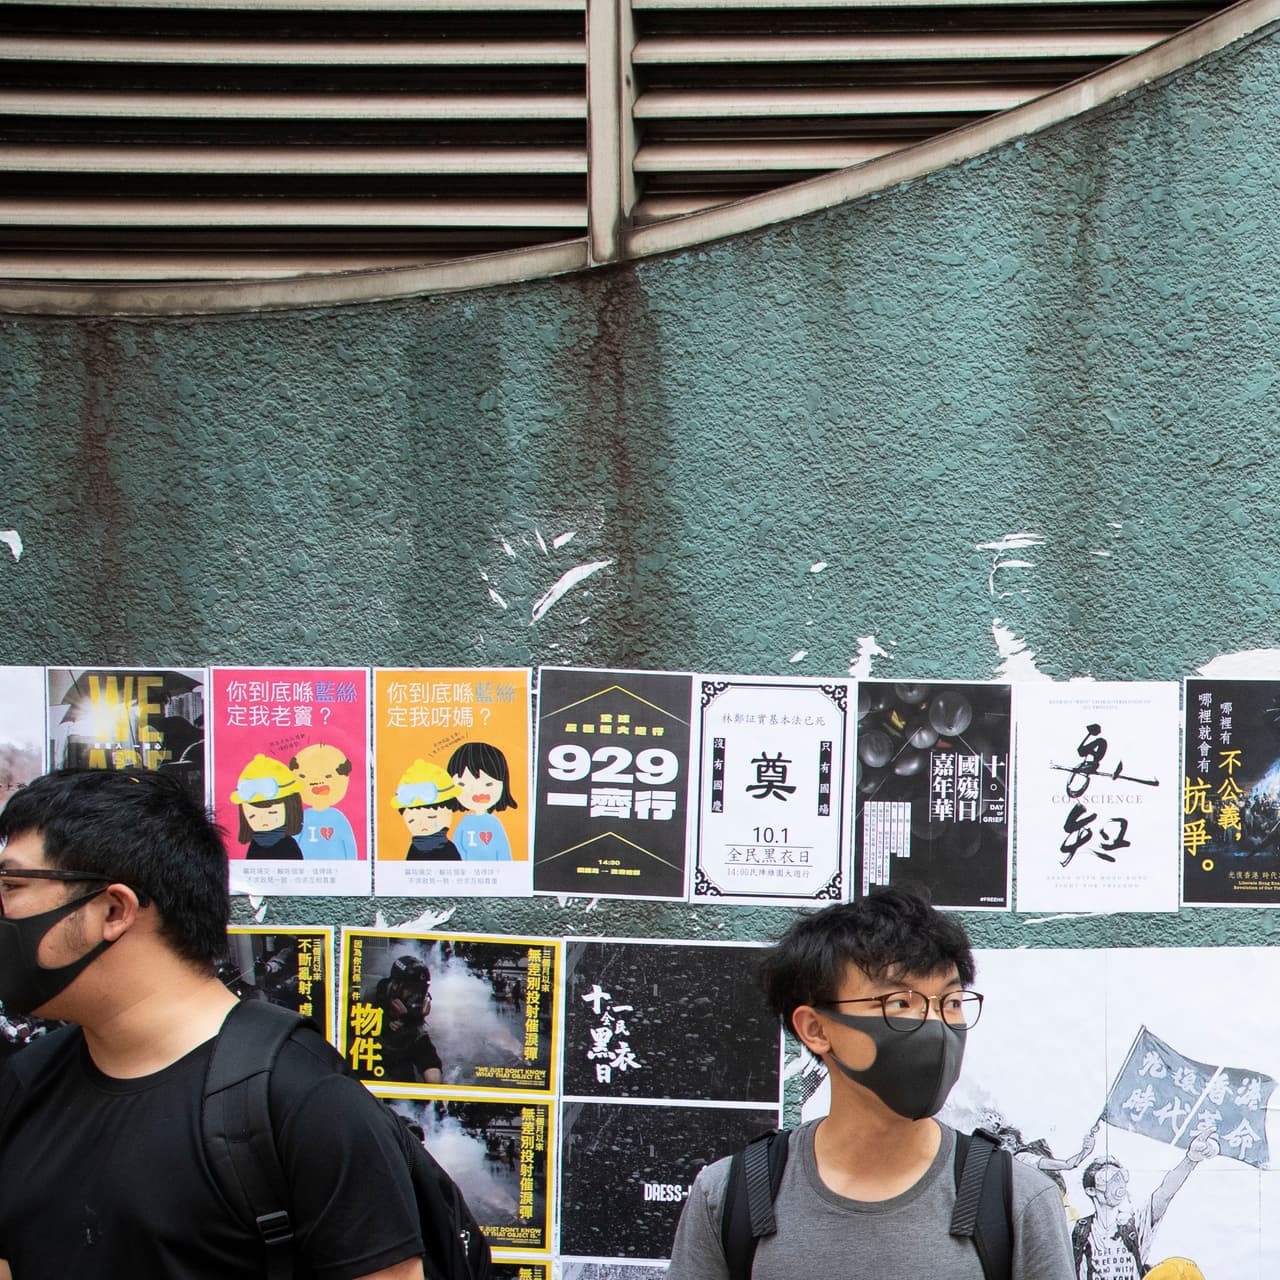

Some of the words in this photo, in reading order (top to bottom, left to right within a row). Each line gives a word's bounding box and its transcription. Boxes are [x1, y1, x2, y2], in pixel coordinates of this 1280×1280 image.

[1197, 692, 1213, 774] 哪裡就會有
[1219, 702, 1233, 745] 哪裡有
[547, 744, 679, 785] 929
[745, 751, 797, 802] 奠
[932, 753, 955, 822] 嘉年華
[956, 754, 980, 822] 國殤日
[547, 788, 677, 821] 一齊行
[727, 847, 810, 864] 全民黑衣日
[753, 827, 789, 844] 10.1
[523, 948, 542, 1061] 無差別投射催淚彈
[350, 1002, 385, 1078] 物件。
